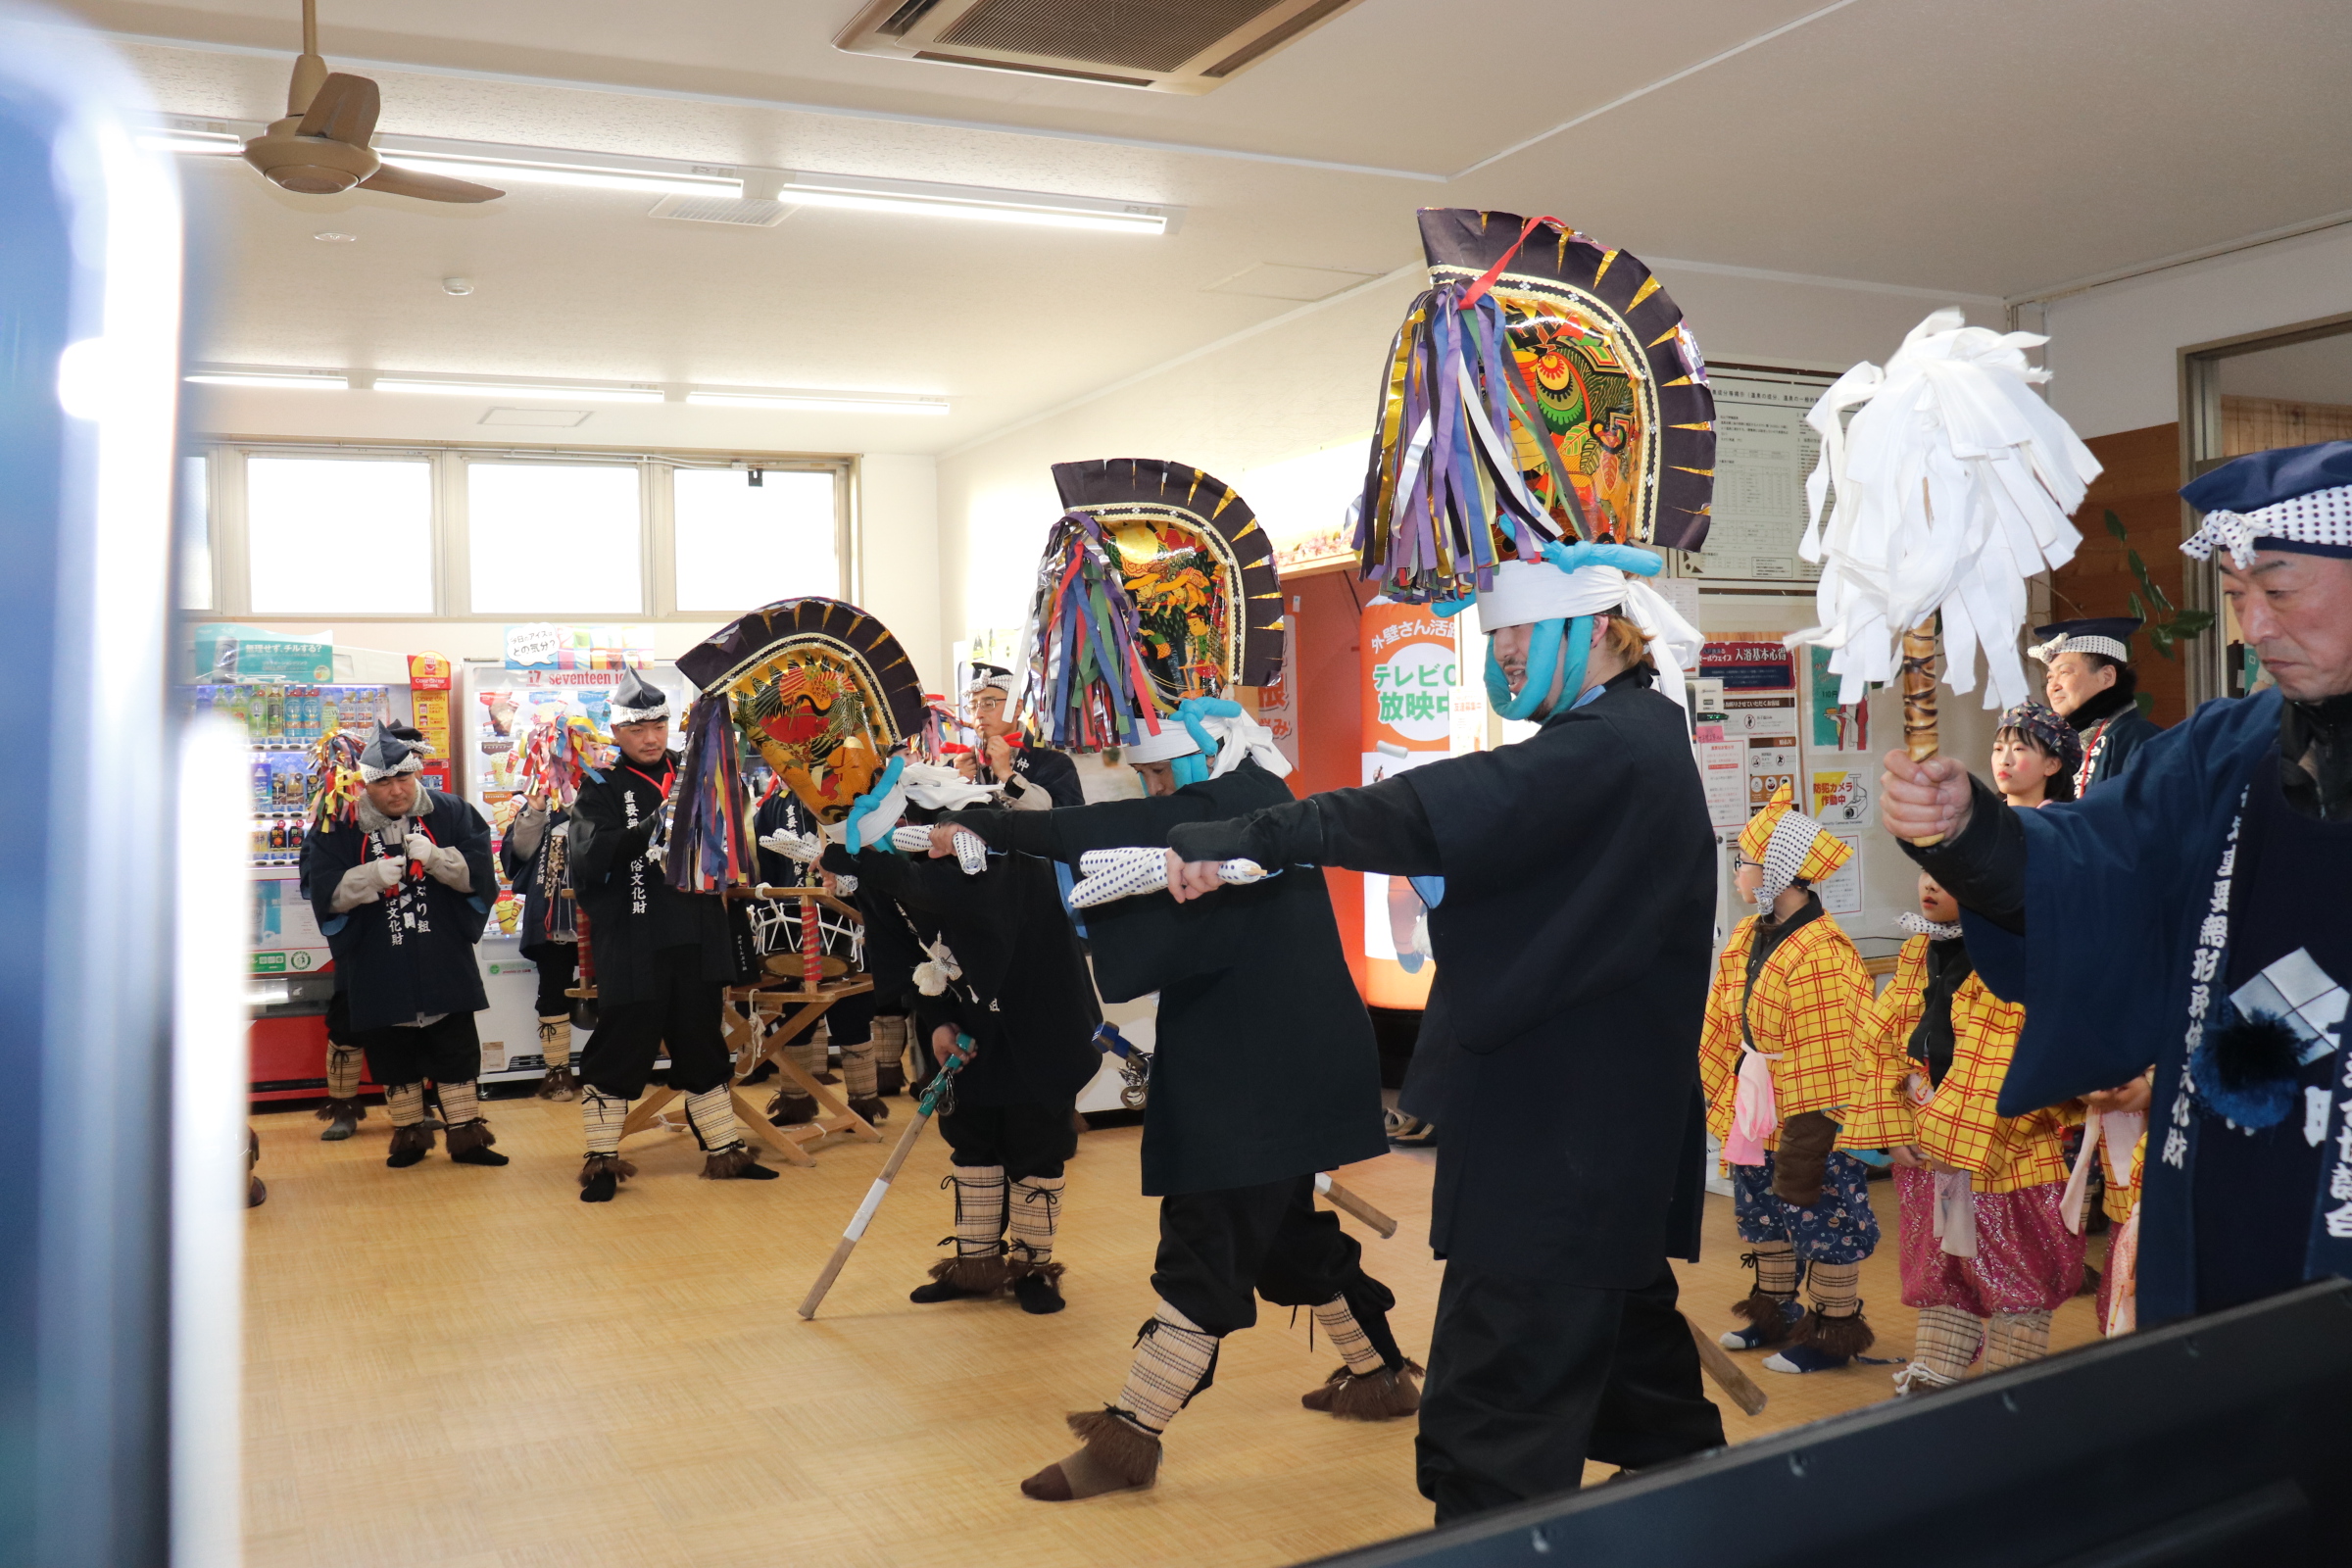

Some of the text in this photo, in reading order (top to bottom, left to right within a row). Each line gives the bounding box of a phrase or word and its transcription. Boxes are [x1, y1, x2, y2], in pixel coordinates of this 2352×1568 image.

[1735, 648, 1788, 662] 入浴基本心得
[549, 671, 612, 685] seventeen
[1813, 782, 1853, 794] 防犯カメラ
[1821, 795, 1846, 806] 作動中
[623, 789, 648, 915] 重要無俗文化財
